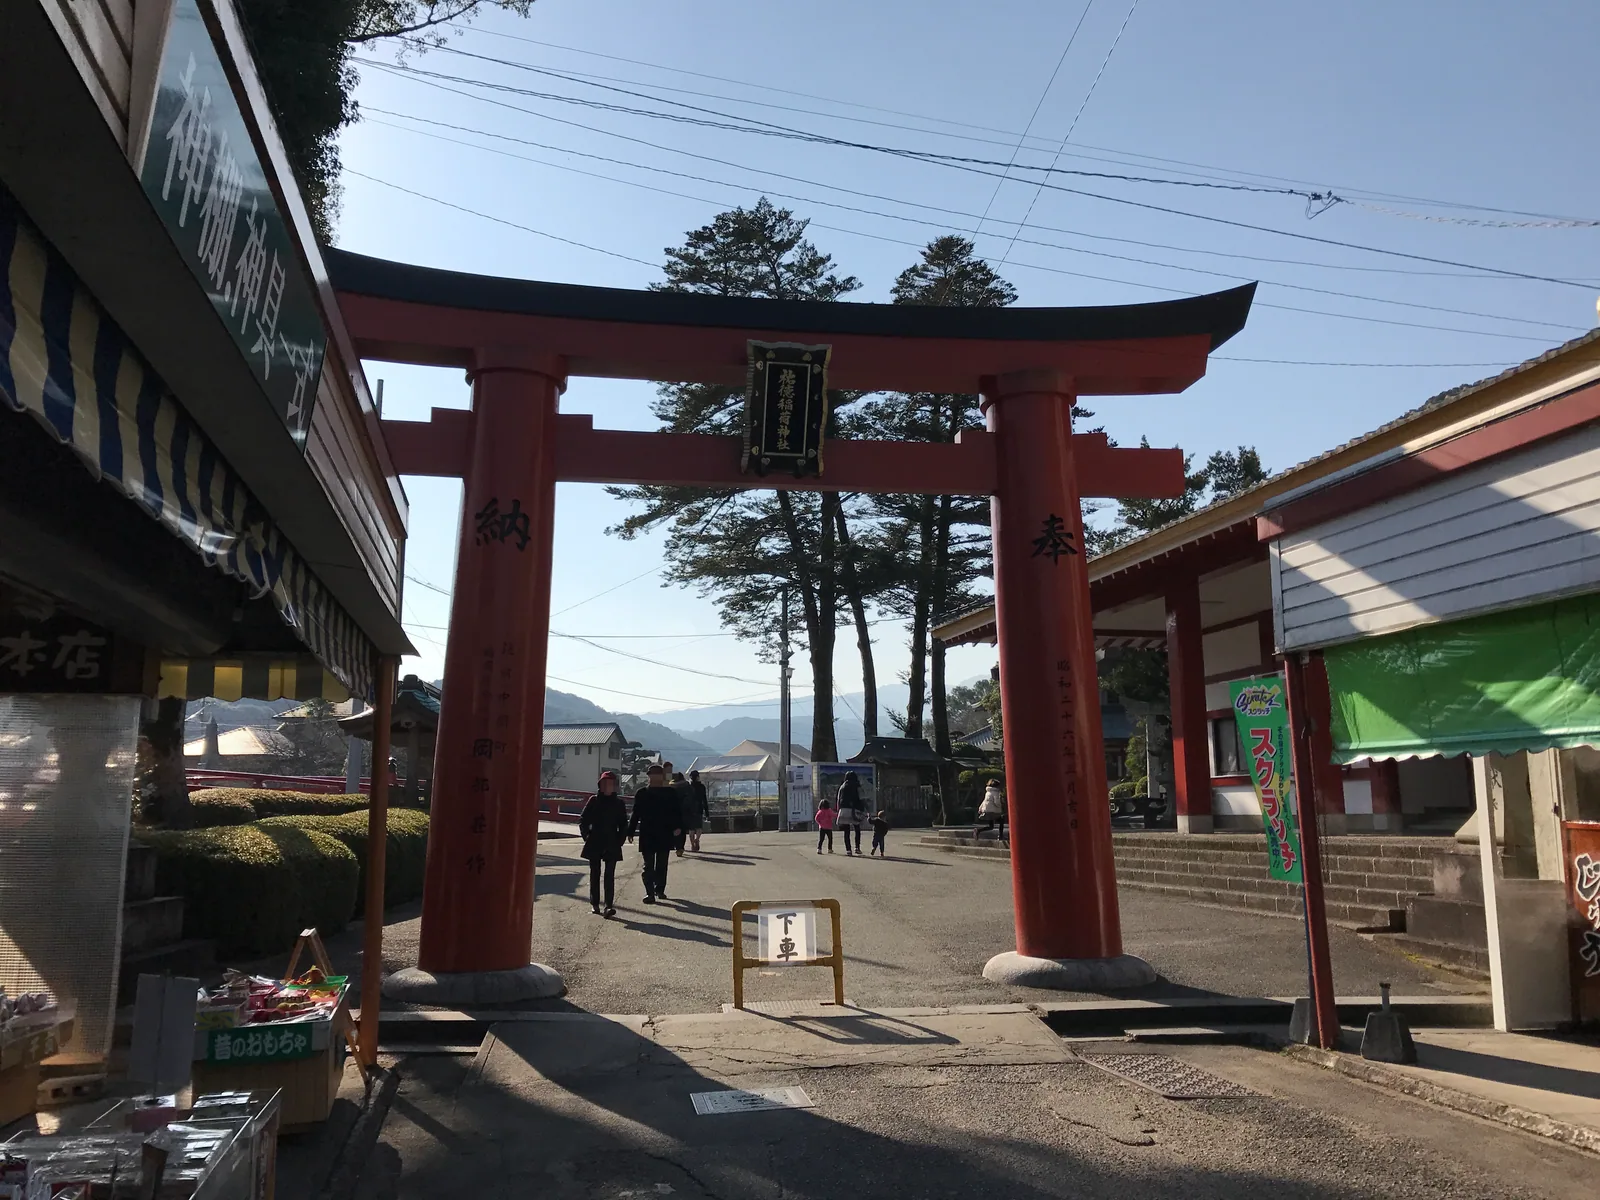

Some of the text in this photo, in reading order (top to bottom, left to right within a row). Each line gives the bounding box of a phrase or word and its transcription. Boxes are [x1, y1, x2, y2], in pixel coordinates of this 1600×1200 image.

[474, 497, 531, 551] 納
[1030, 513, 1079, 566] 奉
[0, 629, 107, 680] 本店
[1250, 727, 1297, 873] スクラッチ
[776, 911, 799, 962] 下車
[213, 1029, 307, 1060] 昔のおもちゃ
